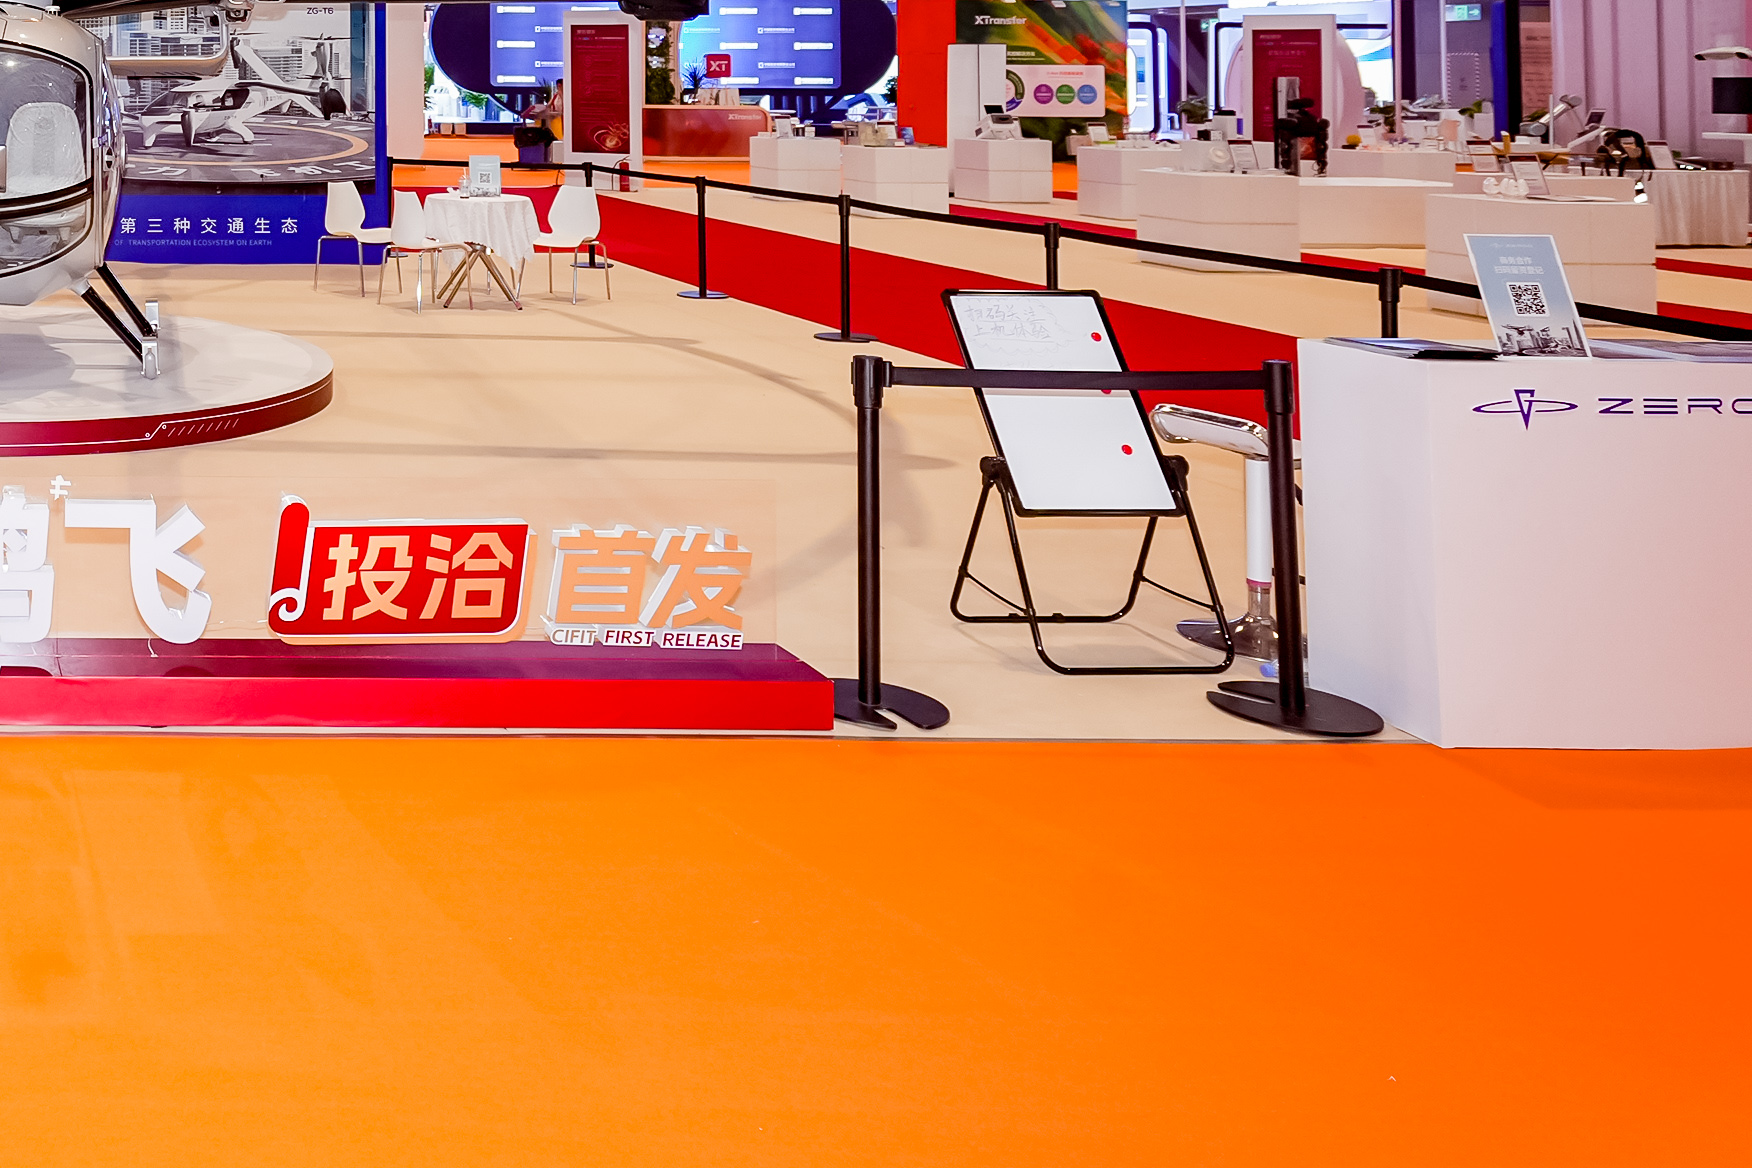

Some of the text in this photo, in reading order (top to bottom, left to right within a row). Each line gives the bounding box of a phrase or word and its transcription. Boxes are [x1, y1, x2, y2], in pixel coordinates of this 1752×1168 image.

[306, 7, 334, 15] ZG-T6
[975, 15, 1027, 25] XTransfer
[709, 60, 728, 72] XT
[120, 217, 298, 234] 第三种交通生态
[249, 239, 273, 247] EARTH
[322, 532, 515, 622] 投洽
[552, 523, 752, 629] 首发
[552, 629, 742, 649] CIFIT FIRST RELEASE
